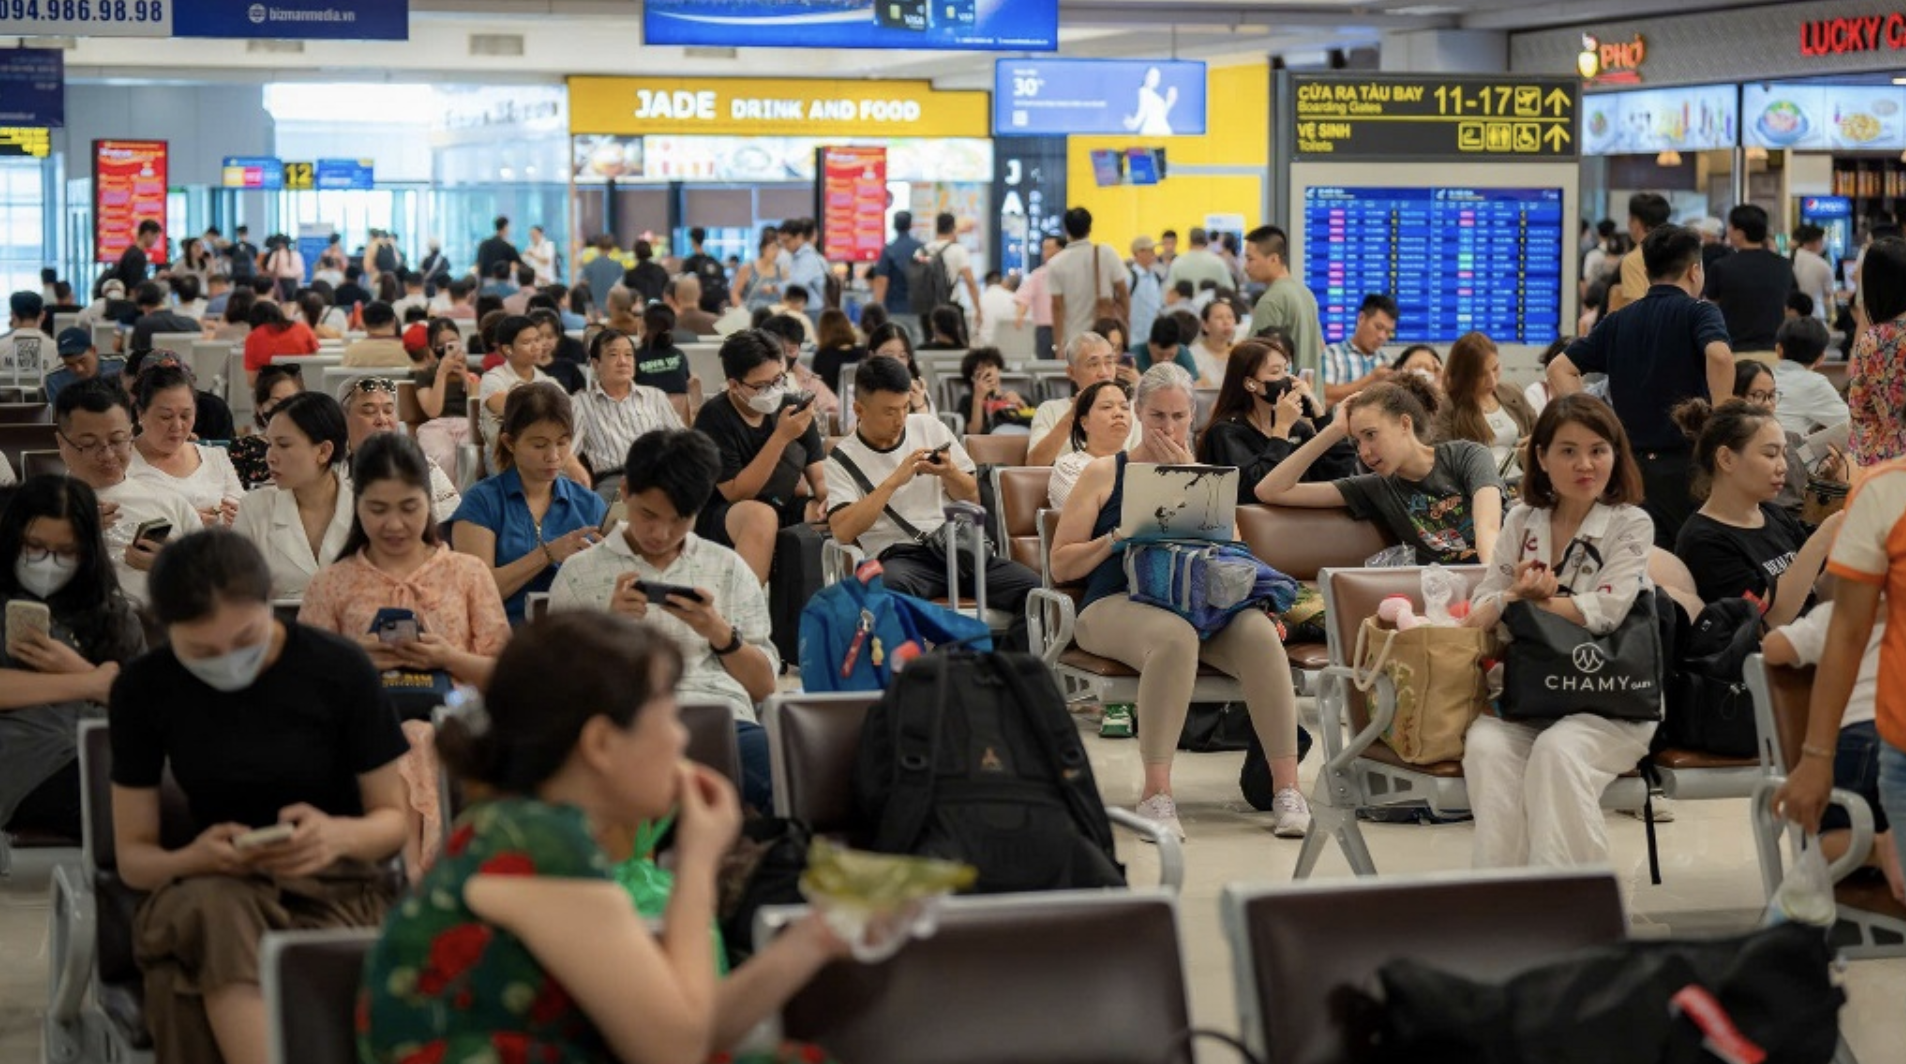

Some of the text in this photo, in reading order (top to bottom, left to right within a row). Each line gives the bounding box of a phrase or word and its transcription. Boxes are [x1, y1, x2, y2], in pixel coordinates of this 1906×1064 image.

[269, 8, 355, 21] bizmanmedia.vn
[1800, 11, 1906, 56] LUCKY C
[634, 89, 920, 121] JADE DRINK AND FOOD
[1297, 83, 1514, 115] CỬA RA TÀU BAY 11-17
[1297, 101, 1382, 115] Boarding Gates
[1297, 121, 1351, 141] VỆ SINH
[1297, 139, 1333, 152] Toilets
[285, 163, 314, 189] 12
[1544, 675, 1630, 692] CHAMY
